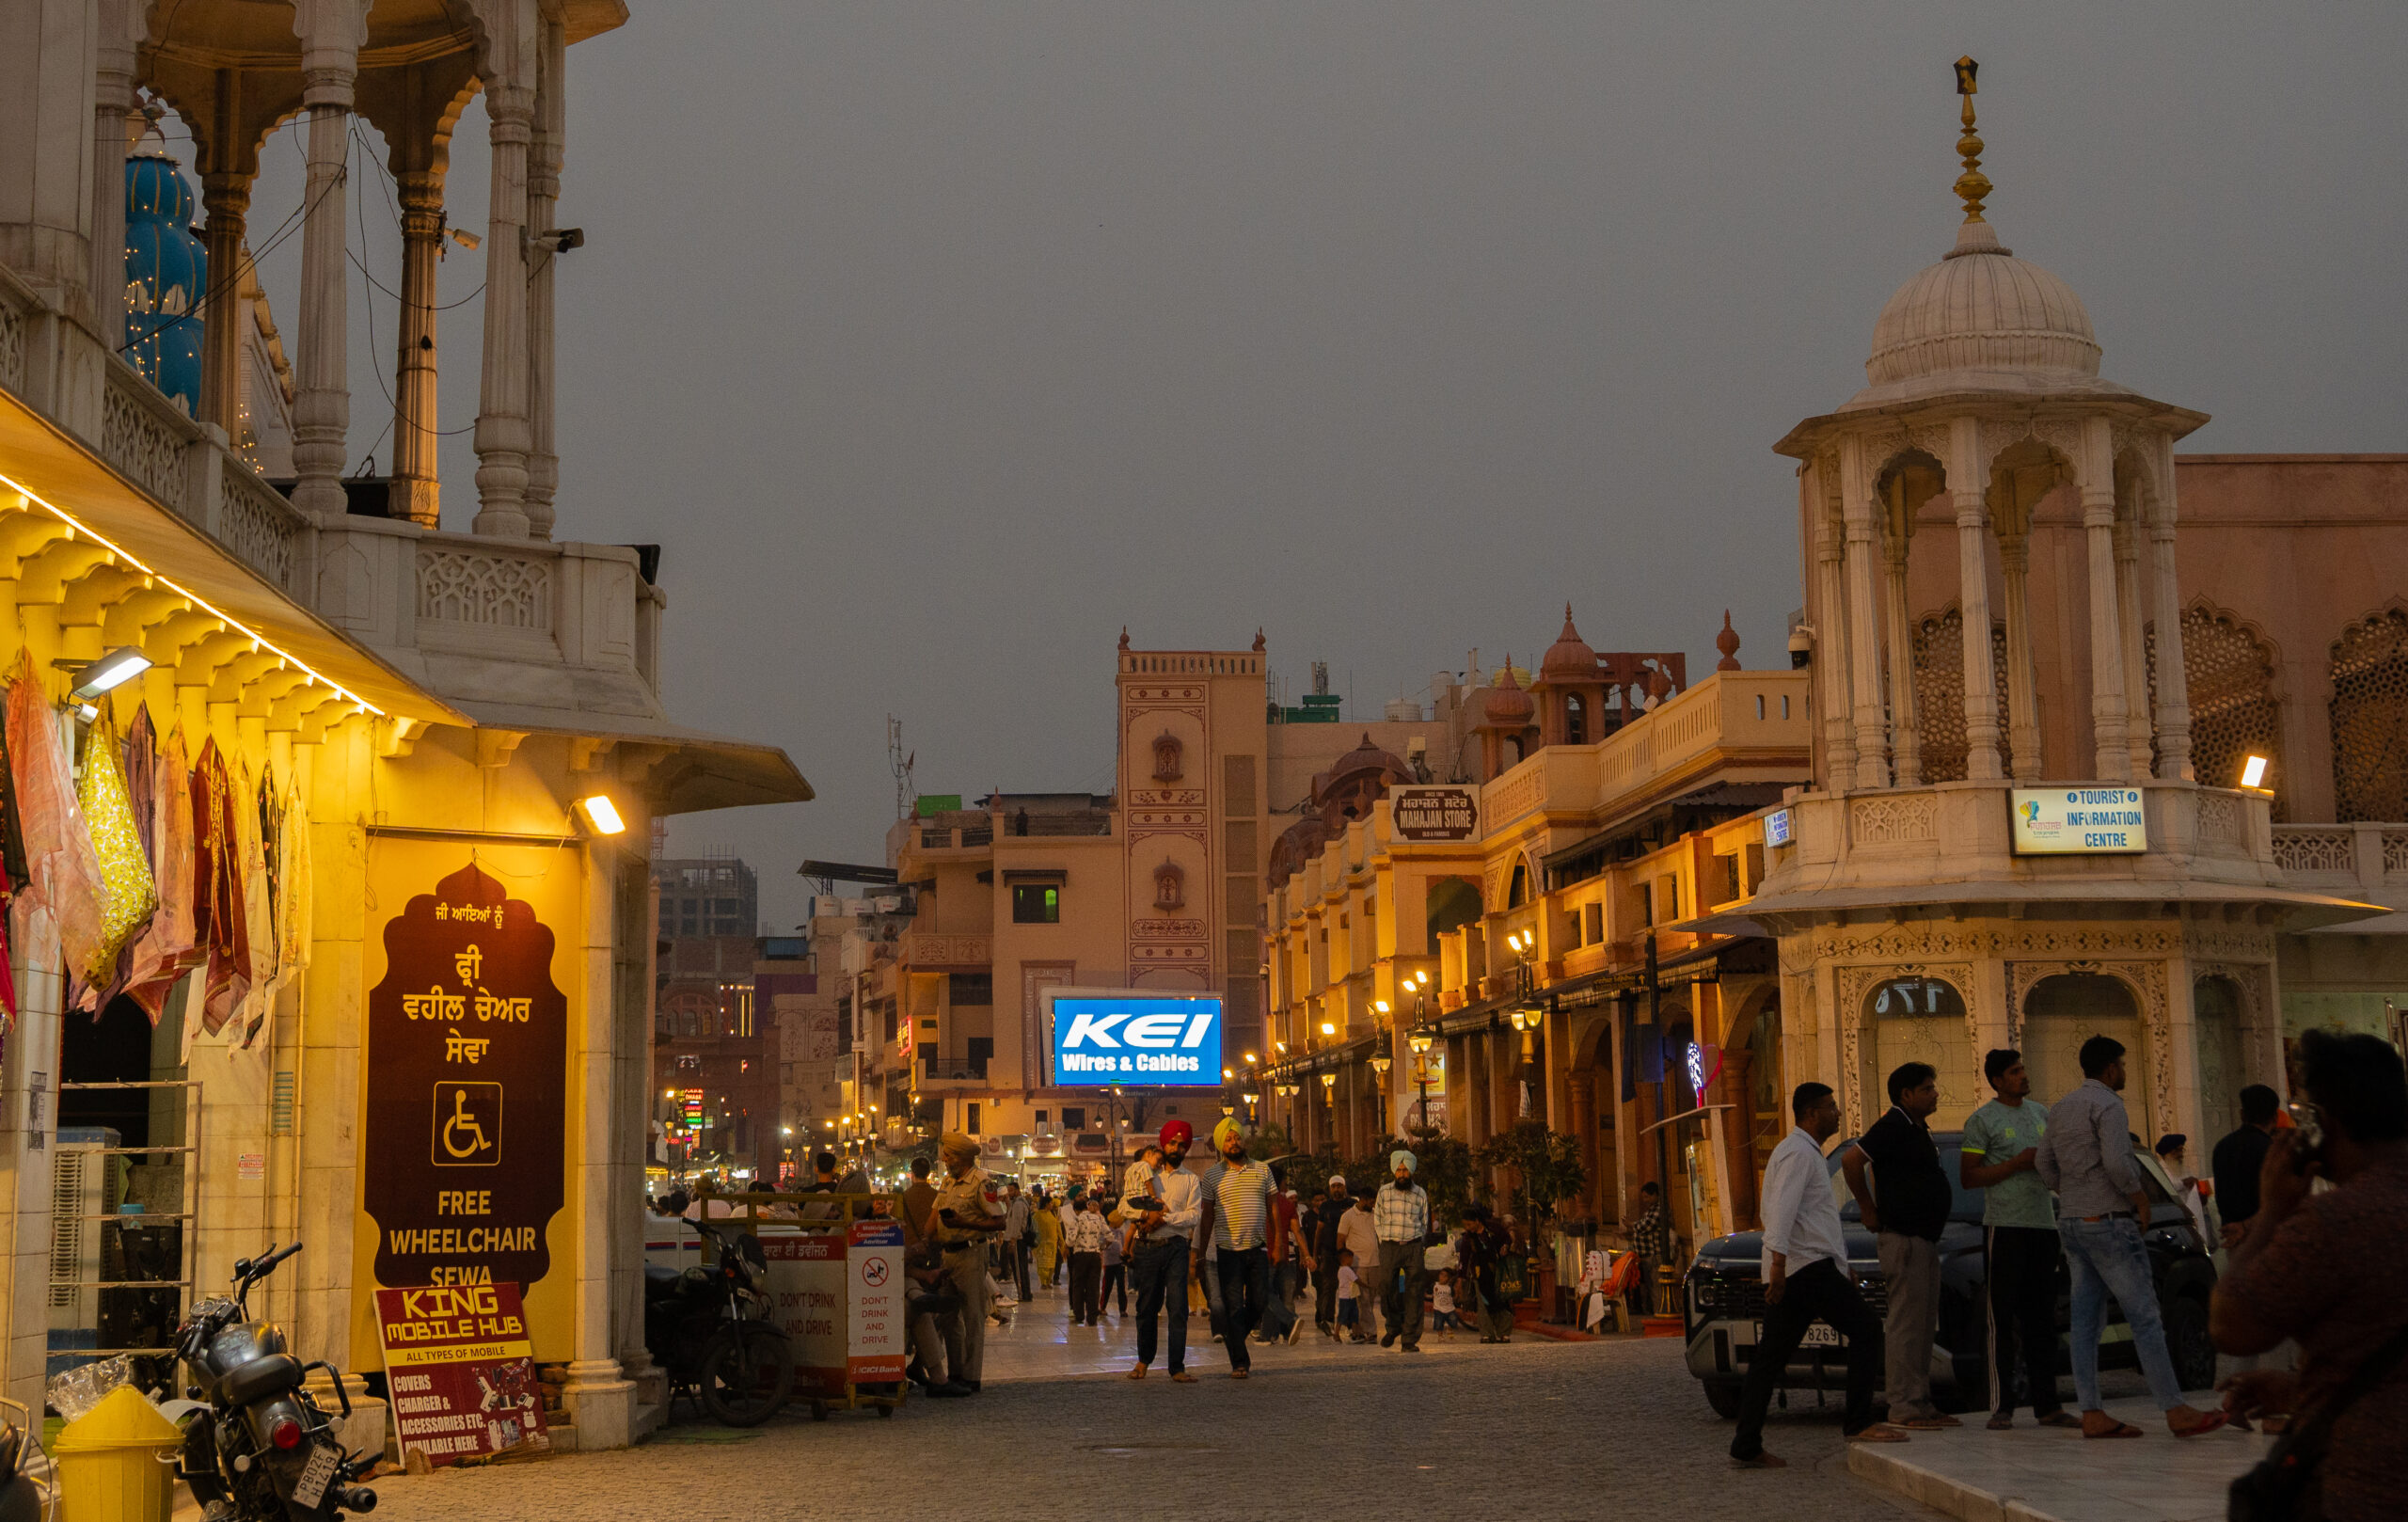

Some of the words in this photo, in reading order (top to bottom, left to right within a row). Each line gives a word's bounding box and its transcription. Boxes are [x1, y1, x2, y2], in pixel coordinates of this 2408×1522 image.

[1402, 798, 1439, 808] ਮਹਾਜਨ
[2079, 790, 2125, 804] TOURIST
[1400, 810, 1442, 828] MAHAJAN
[1444, 810, 1471, 828] STORE
[2067, 811, 2142, 826] INFORMATION
[2084, 832, 2128, 848] CENTRE
[436, 902, 448, 921] ਜੀ
[452, 904, 490, 923] ਆਇਆਂ
[494, 904, 504, 929] ਨੂੰ
[403, 985, 465, 1022] ਵਹੀਲ
[475, 986, 531, 1023] ਚੇਅਰ
[1062, 1014, 1213, 1048] KEI
[446, 1028, 490, 1064] ਸੇਵਾ
[1062, 1054, 1117, 1071] Wires
[1119, 1054, 1133, 1071] &
[1136, 1053, 1199, 1071] Cables
[438, 1190, 491, 1215] FREE
[390, 1227, 536, 1255] WHEELCHAIR
[430, 1266, 492, 1287] SEWA
[403, 1287, 499, 1319] KING
[780, 1293, 807, 1308] DON'T
[809, 1293, 836, 1308] DRINK
[862, 1309, 889, 1318] DRINK
[387, 1320, 475, 1342] MOBILE
[479, 1316, 523, 1337] HUB
[785, 1321, 804, 1335] AND
[805, 1321, 832, 1335] DRIVE
[864, 1323, 885, 1331] AND
[1808, 1327, 1836, 1341] 8269
[862, 1336, 889, 1344] DRIVE
[406, 1352, 423, 1362] ALL
[425, 1350, 453, 1360] TYPES
[456, 1349, 468, 1358] OF
[469, 1346, 506, 1357] MOBILE
[394, 1374, 432, 1393] COVERS
[397, 1396, 441, 1414] CHARGER
[443, 1397, 451, 1410] &
[402, 1415, 466, 1435] ACCESSORIES
[467, 1413, 486, 1431] ETC.
[454, 1435, 479, 1451] HERE
[310, 1457, 337, 1498] H1419
